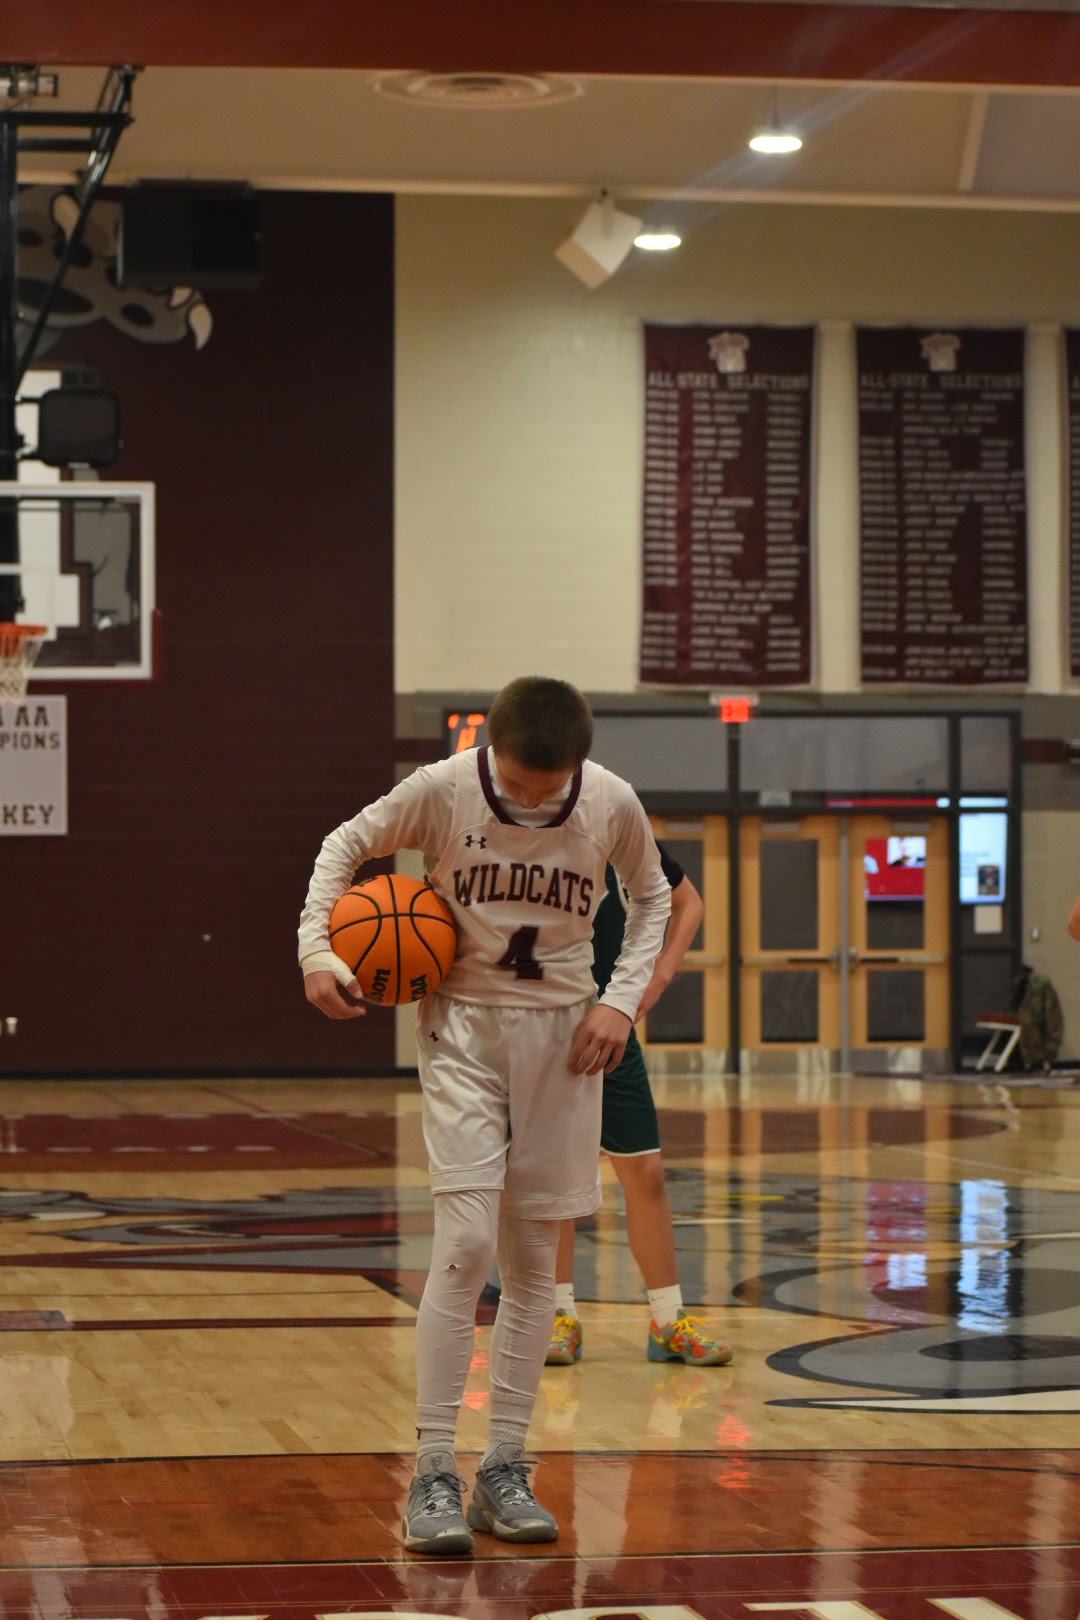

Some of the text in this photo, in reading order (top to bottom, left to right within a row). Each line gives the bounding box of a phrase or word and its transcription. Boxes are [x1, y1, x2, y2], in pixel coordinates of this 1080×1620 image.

[3, 804, 53, 825] KEY
[453, 863, 594, 917] WILDCATS
[496, 924, 544, 980] 4
